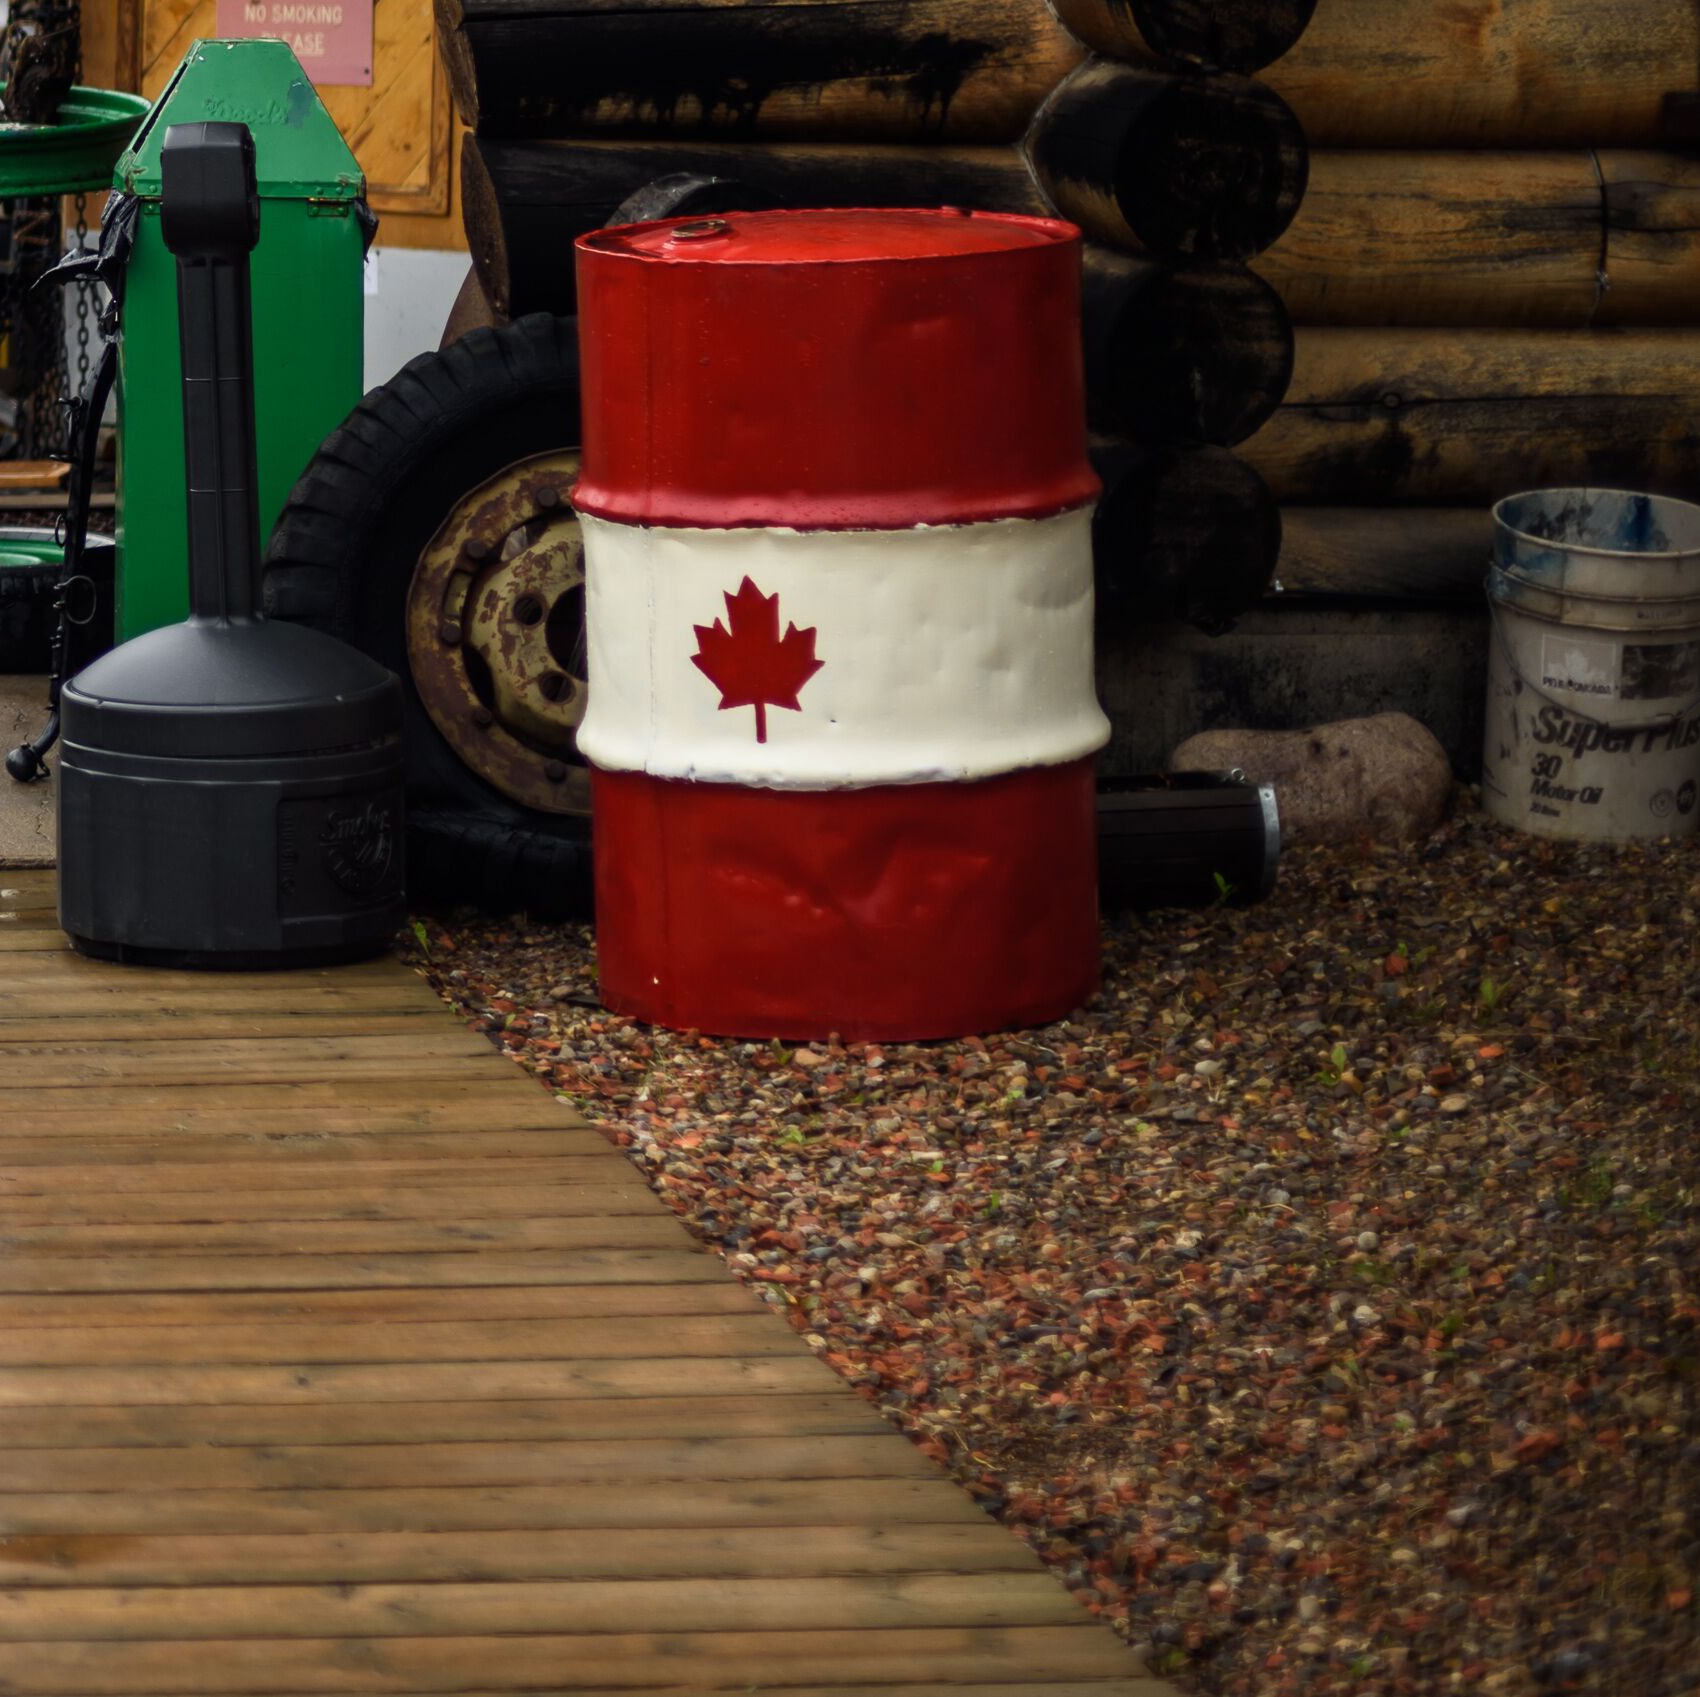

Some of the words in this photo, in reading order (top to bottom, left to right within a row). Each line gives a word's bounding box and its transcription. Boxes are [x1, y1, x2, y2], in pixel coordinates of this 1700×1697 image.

[244, 4, 266, 23] NO
[272, 5, 342, 24] SMOKING
[1531, 751, 1563, 780] 30
[1530, 778, 1578, 802] Motor
[1580, 786, 1605, 804] Oil
